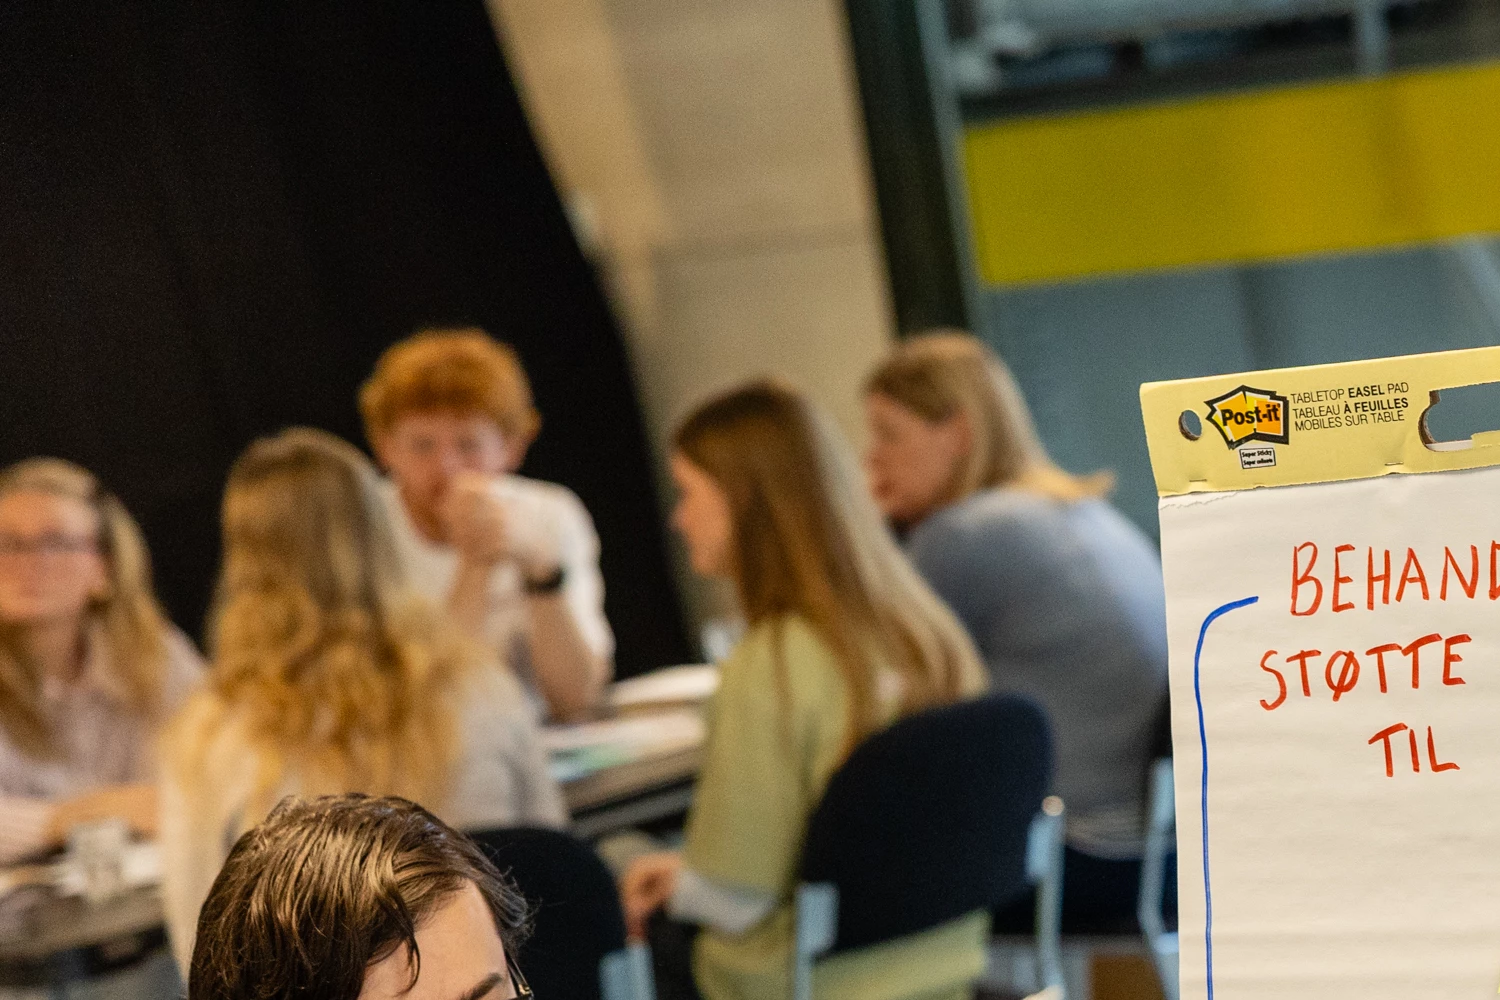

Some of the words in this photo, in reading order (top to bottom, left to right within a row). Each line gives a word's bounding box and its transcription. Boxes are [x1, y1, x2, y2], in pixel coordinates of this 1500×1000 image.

[1290, 388, 1345, 404] TABLETOP
[1348, 385, 1384, 398] EASEL
[1387, 382, 1409, 393] PAD
[1221, 403, 1281, 427] Post-it
[1293, 404, 1341, 419] TABLEAU
[1343, 400, 1352, 413] À
[1354, 397, 1409, 413] FEUILLES
[1294, 416, 1343, 432] MOBILES
[1345, 413, 1369, 427] SUR
[1373, 410, 1405, 424] TABLE
[1260, 633, 1473, 711] STØTTE
[1368, 722, 1461, 778] TIL
